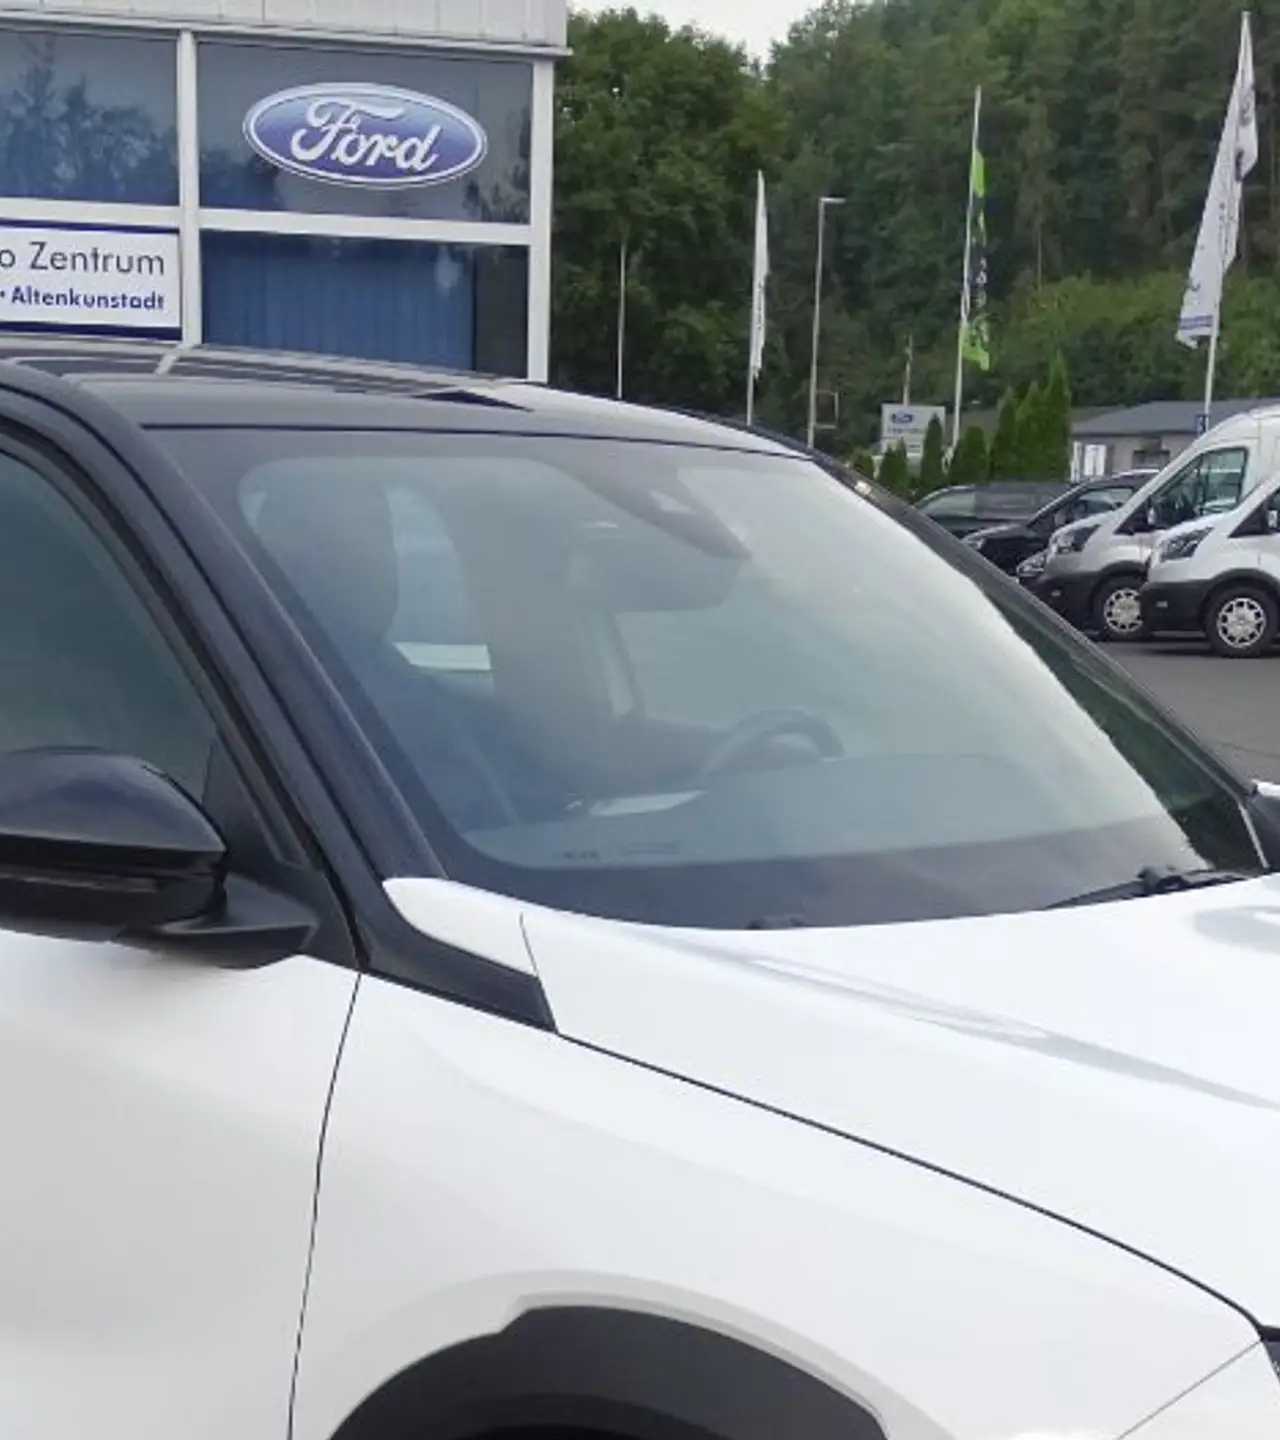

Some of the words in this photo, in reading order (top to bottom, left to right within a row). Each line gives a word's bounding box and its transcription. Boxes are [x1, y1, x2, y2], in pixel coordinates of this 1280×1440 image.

[291, 98, 442, 171] Ford
[28, 240, 165, 276] Zentrum
[10, 286, 166, 310] Altenkunstadt
